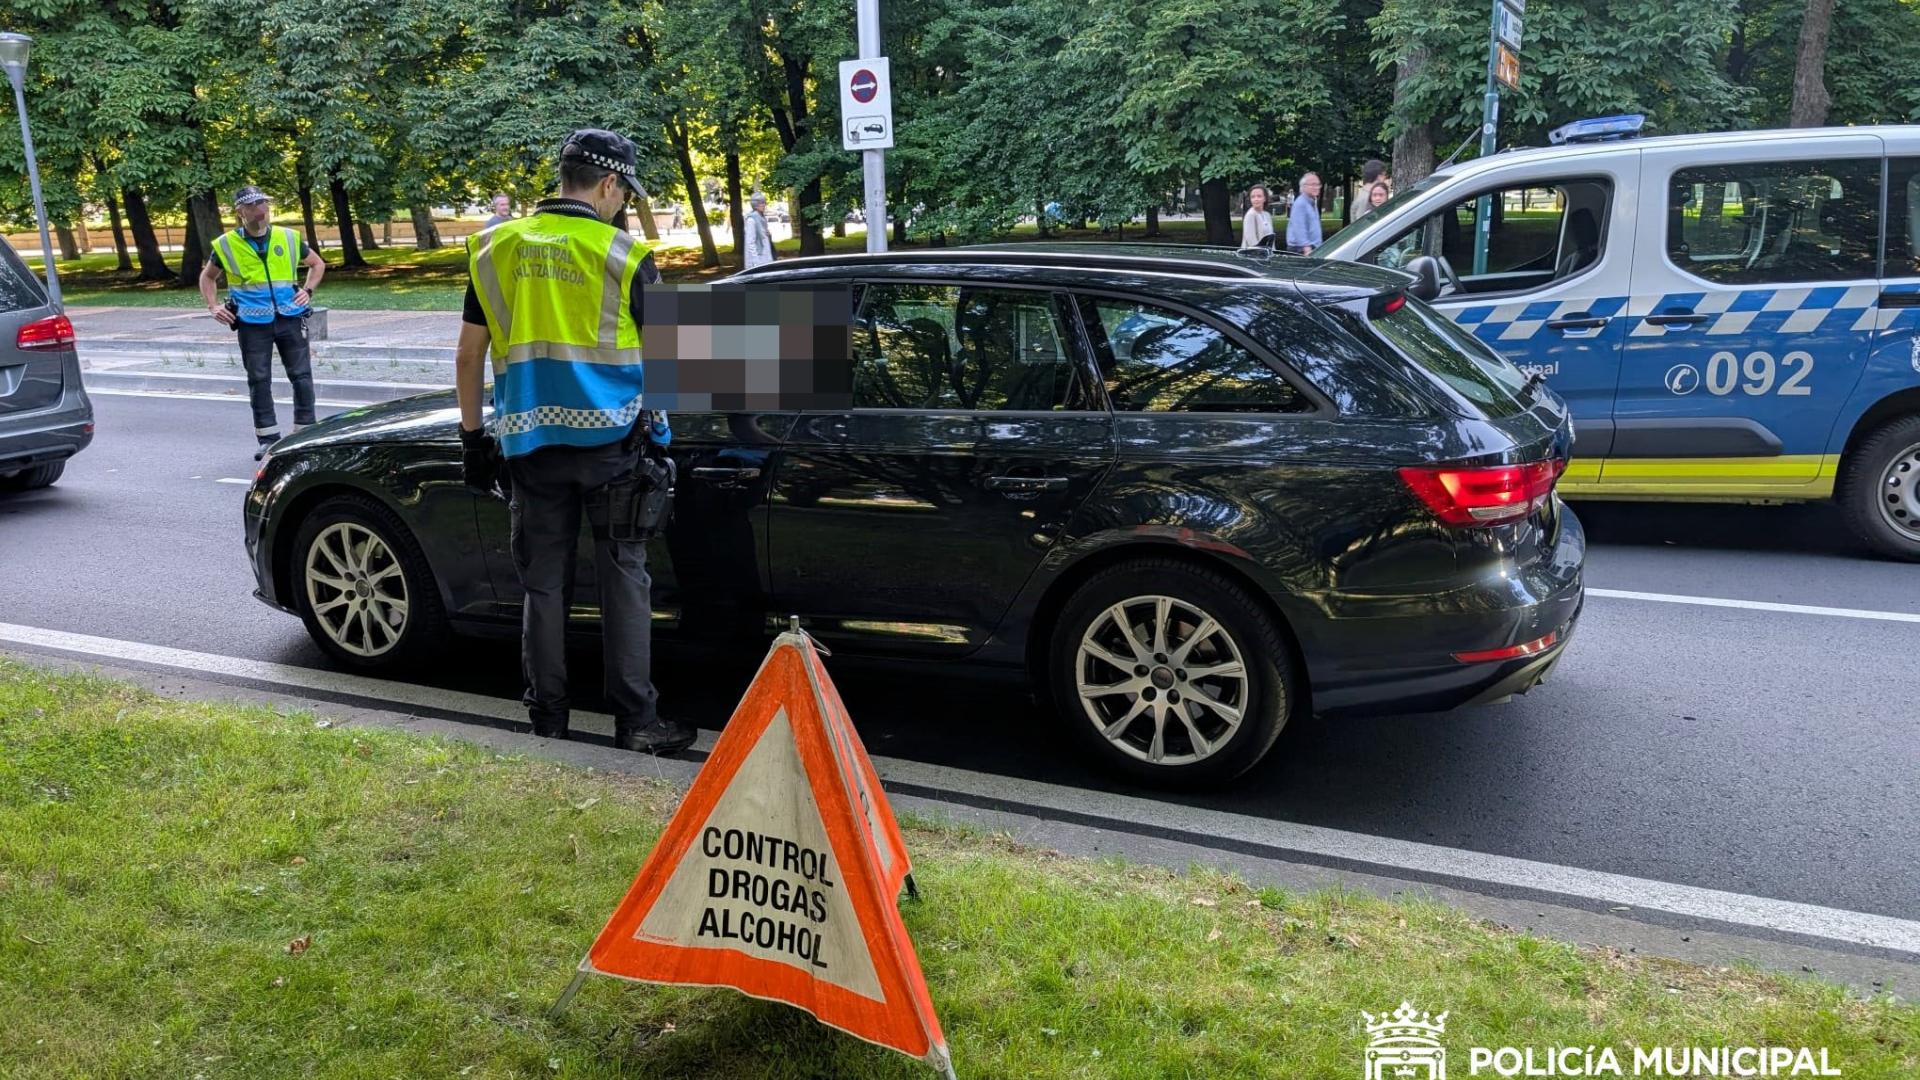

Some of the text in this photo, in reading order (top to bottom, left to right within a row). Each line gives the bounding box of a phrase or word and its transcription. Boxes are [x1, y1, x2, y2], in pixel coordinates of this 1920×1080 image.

[512, 263, 585, 286] ALTZAINGOA
[1705, 351, 1814, 396] 092
[702, 826, 834, 888] CONTROL
[708, 868, 827, 923] DROGAS
[697, 907, 828, 969] ALCOHOL
